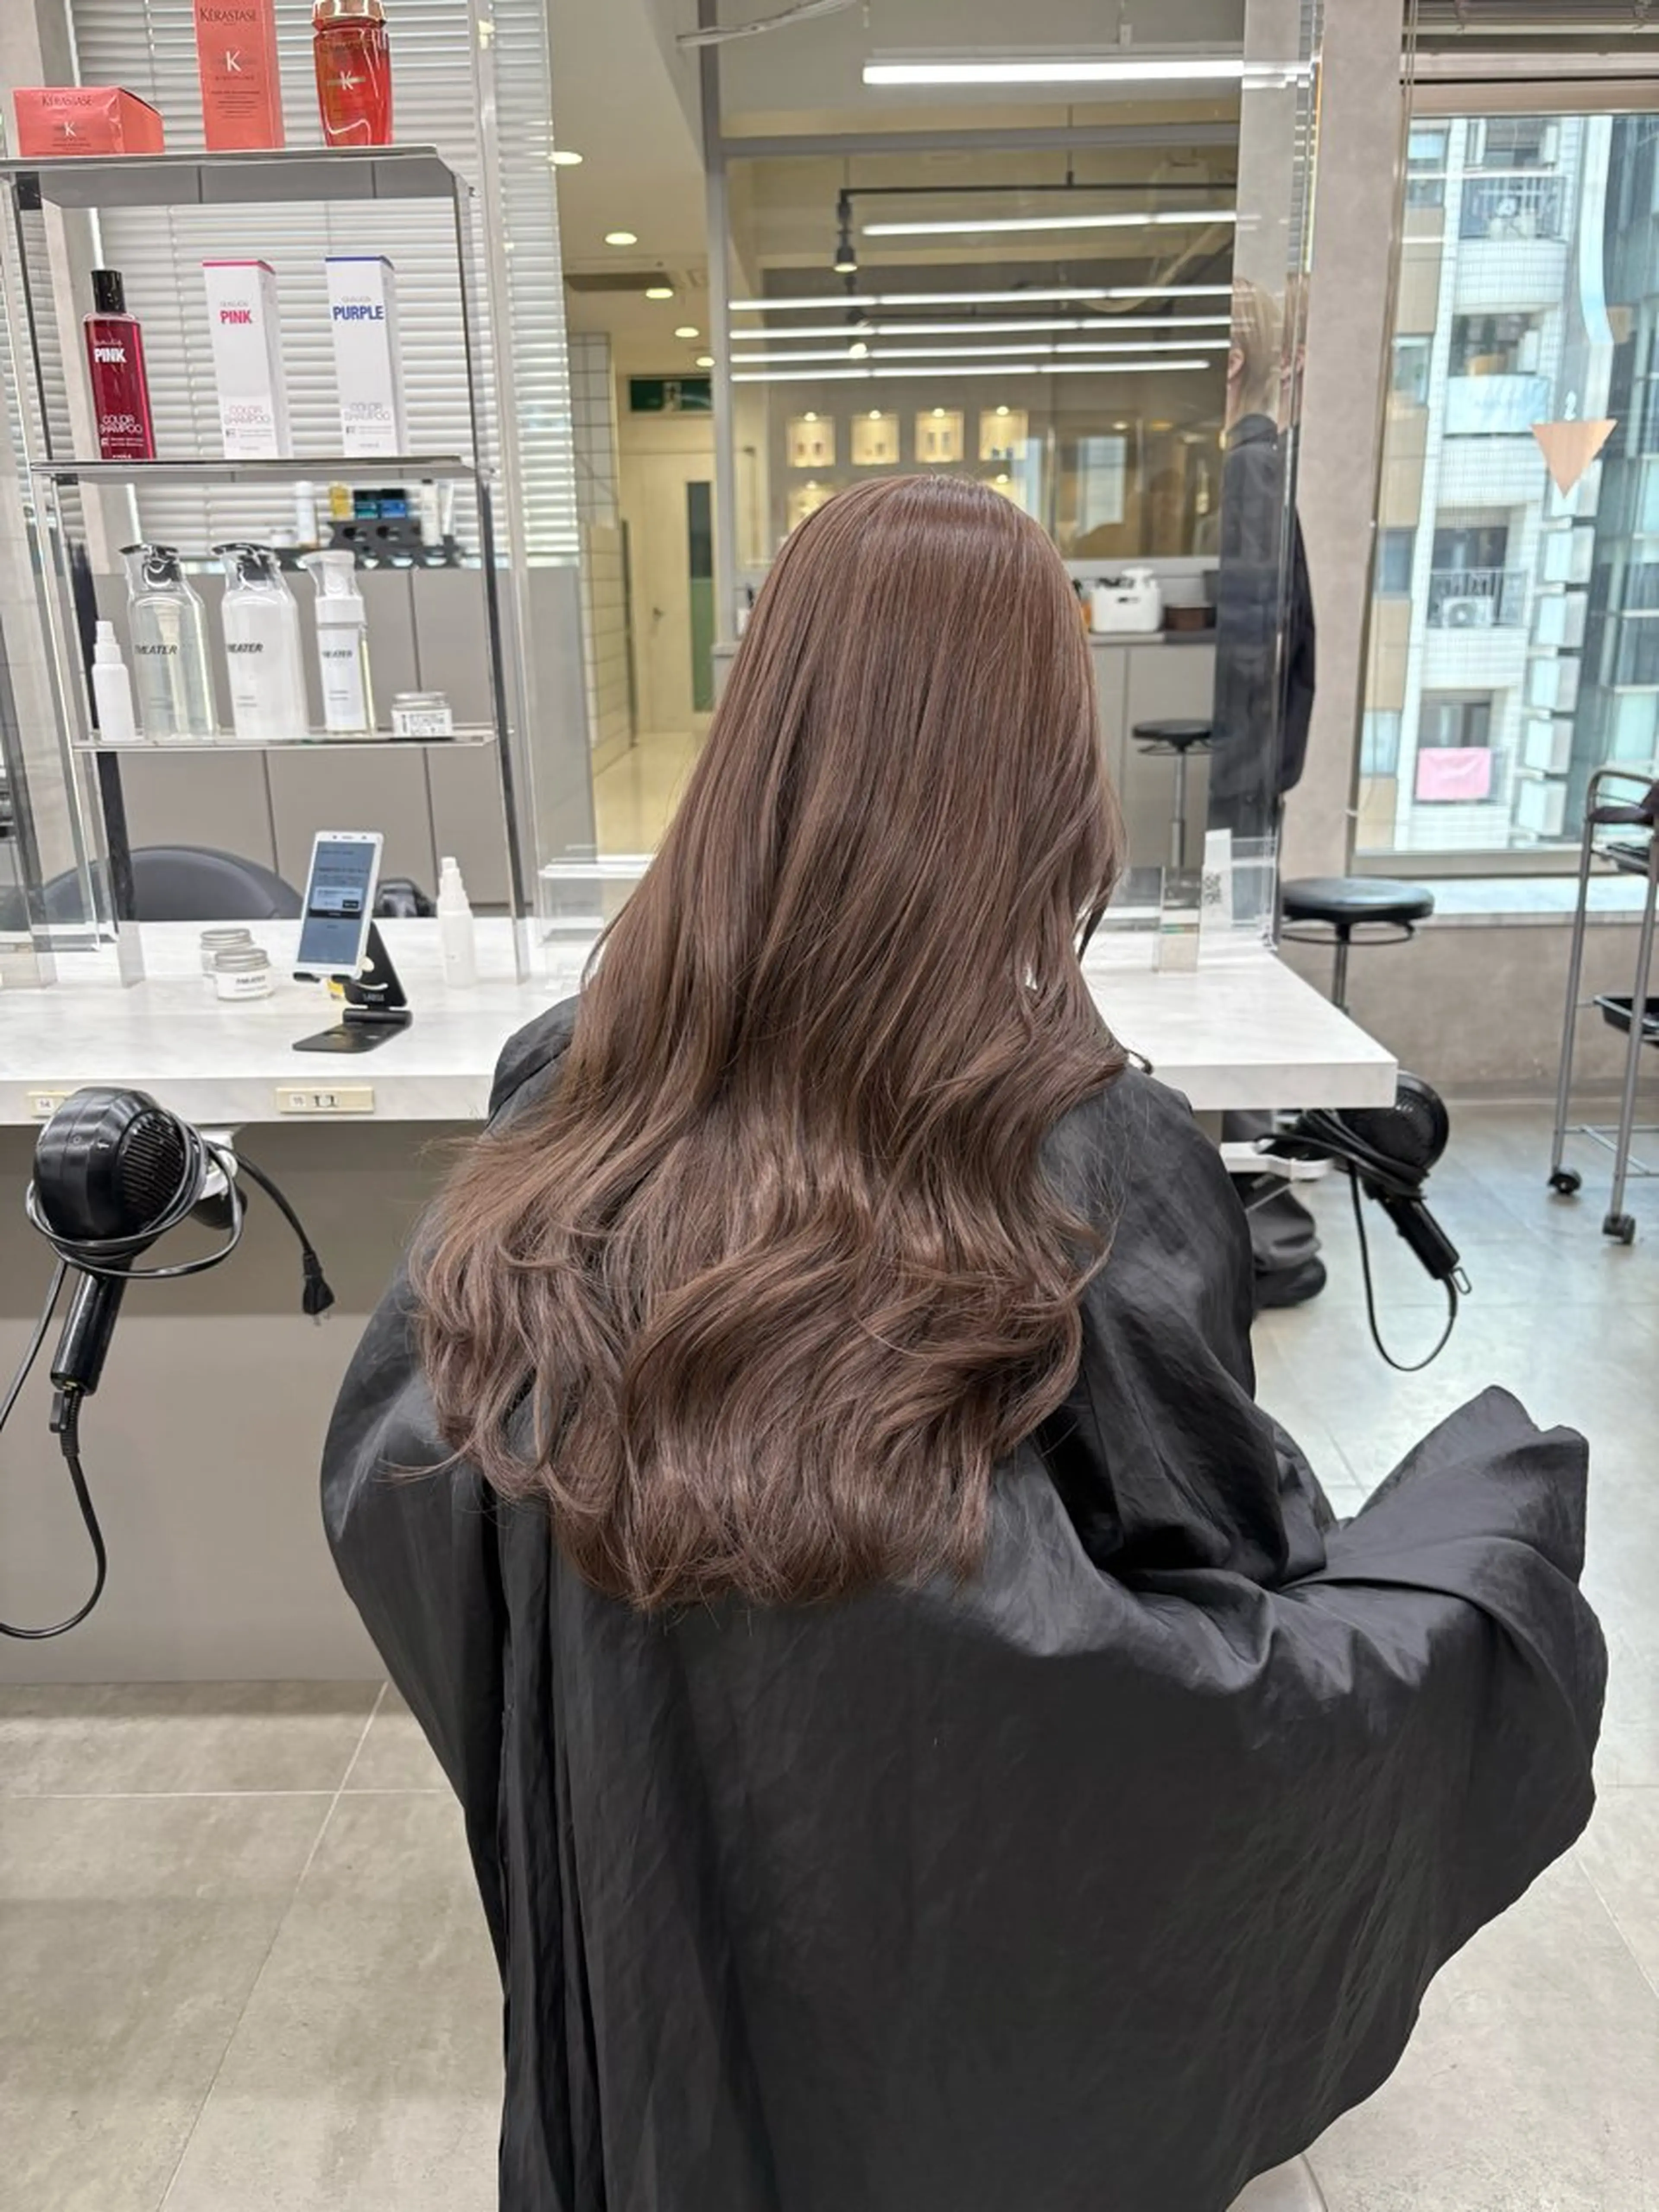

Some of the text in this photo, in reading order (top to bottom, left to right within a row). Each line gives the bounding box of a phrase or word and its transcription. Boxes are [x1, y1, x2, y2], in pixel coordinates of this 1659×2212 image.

[226, 50, 242, 72] K
[340, 70, 354, 90] K
[64, 121, 77, 137] K
[219, 310, 252, 324] PINK
[332, 305, 384, 321] PURPLE
[95, 347, 127, 363] PINK
